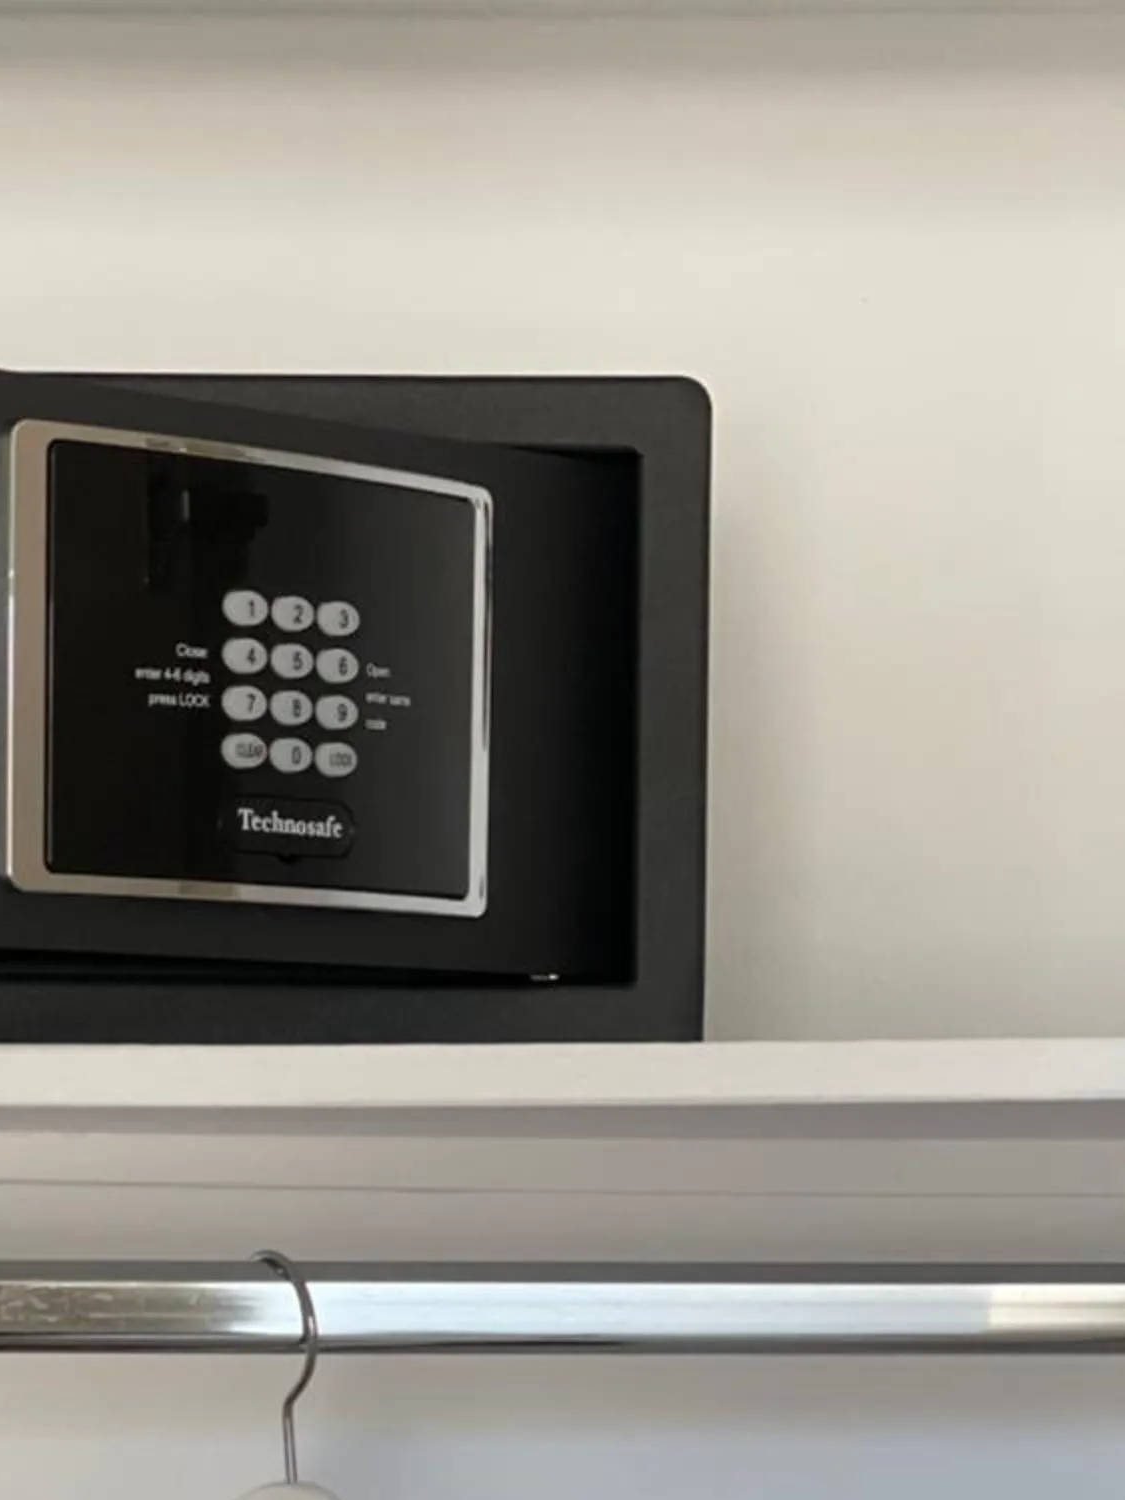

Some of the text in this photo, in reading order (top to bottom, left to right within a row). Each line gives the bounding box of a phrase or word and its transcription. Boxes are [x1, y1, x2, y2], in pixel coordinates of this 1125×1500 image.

[293, 603, 304, 624] 2
[338, 608, 350, 630] 3
[245, 647, 348, 677] 4 5 6
[178, 692, 210, 708] LOCK
[246, 693, 348, 723] 7 8 9
[292, 745, 302, 766] 0
[237, 807, 344, 838] Technosafe
